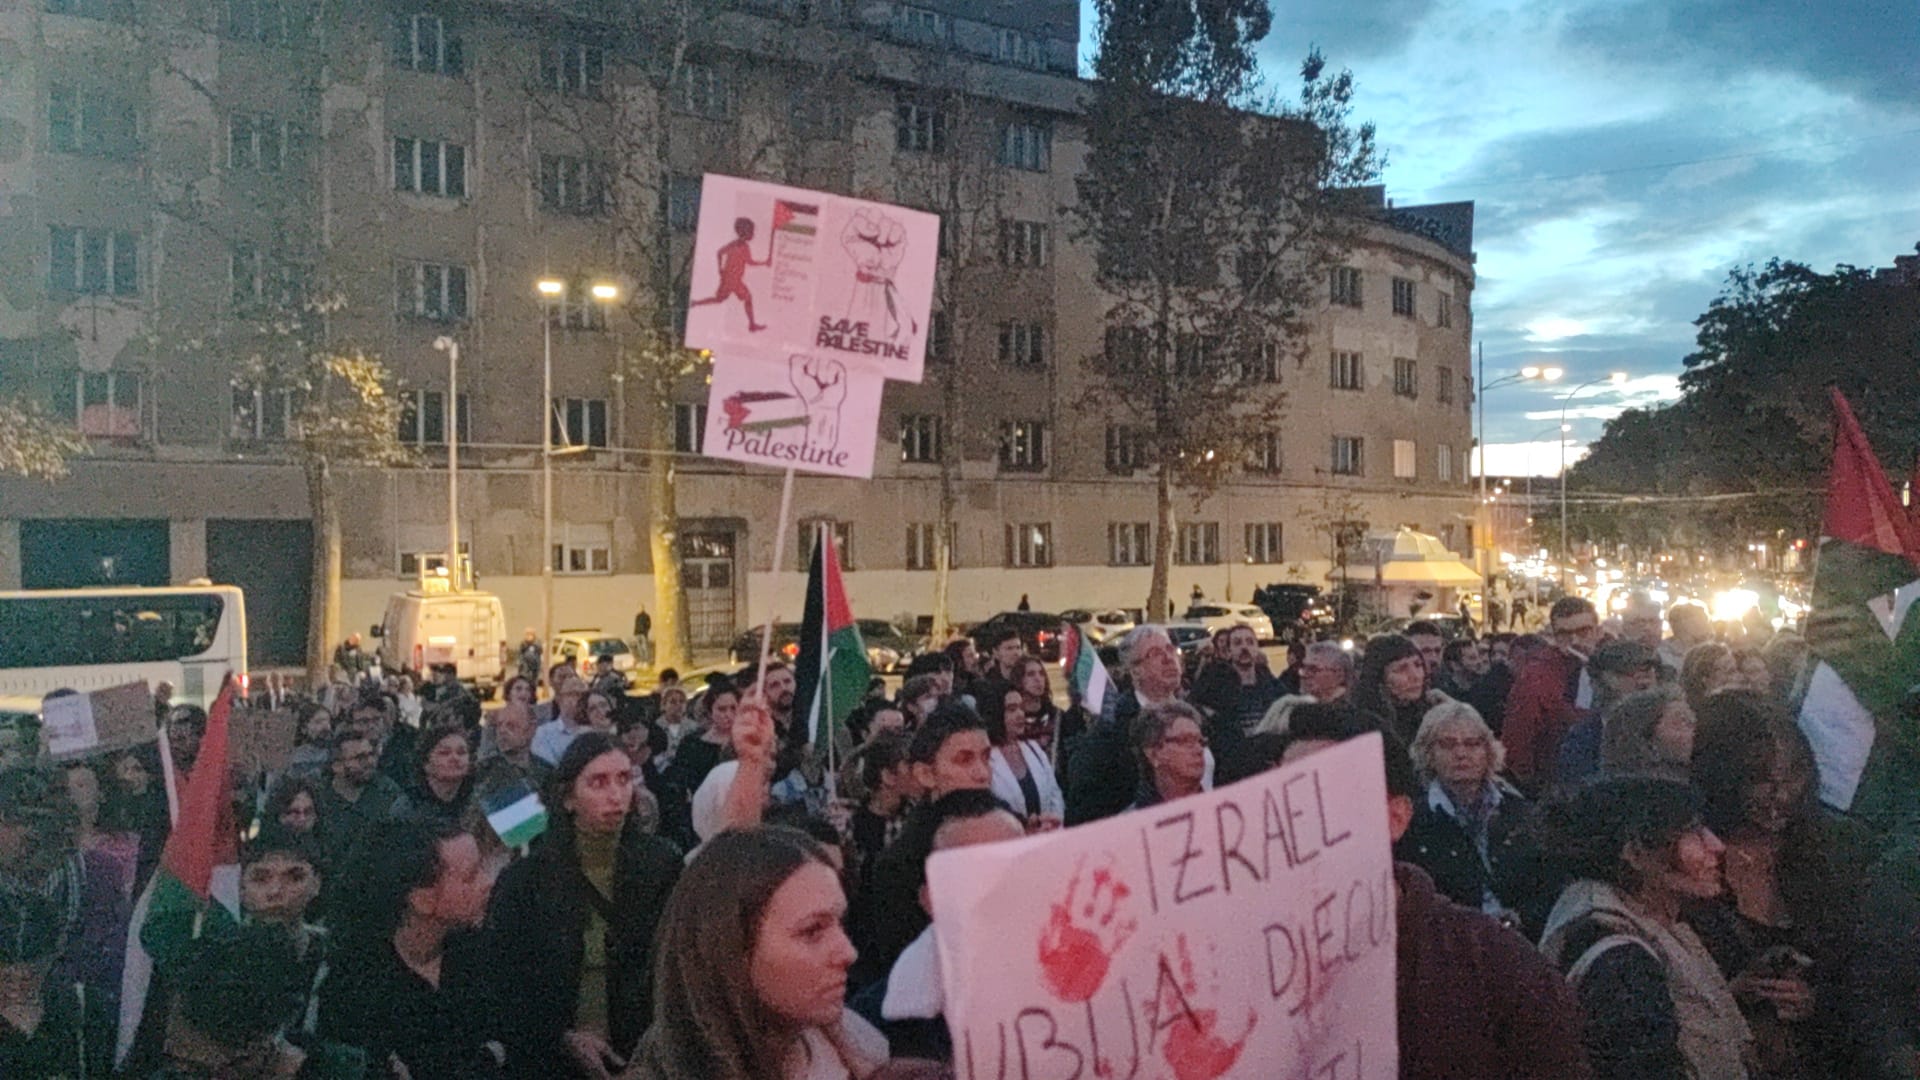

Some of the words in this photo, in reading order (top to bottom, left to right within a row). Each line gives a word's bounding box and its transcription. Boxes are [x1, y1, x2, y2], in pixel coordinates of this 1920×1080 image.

[819, 315, 869, 337] SAVE
[816, 332, 910, 360] PALESTINE
[723, 427, 849, 467] Palestine
[1141, 769, 1352, 914] IZRAEL
